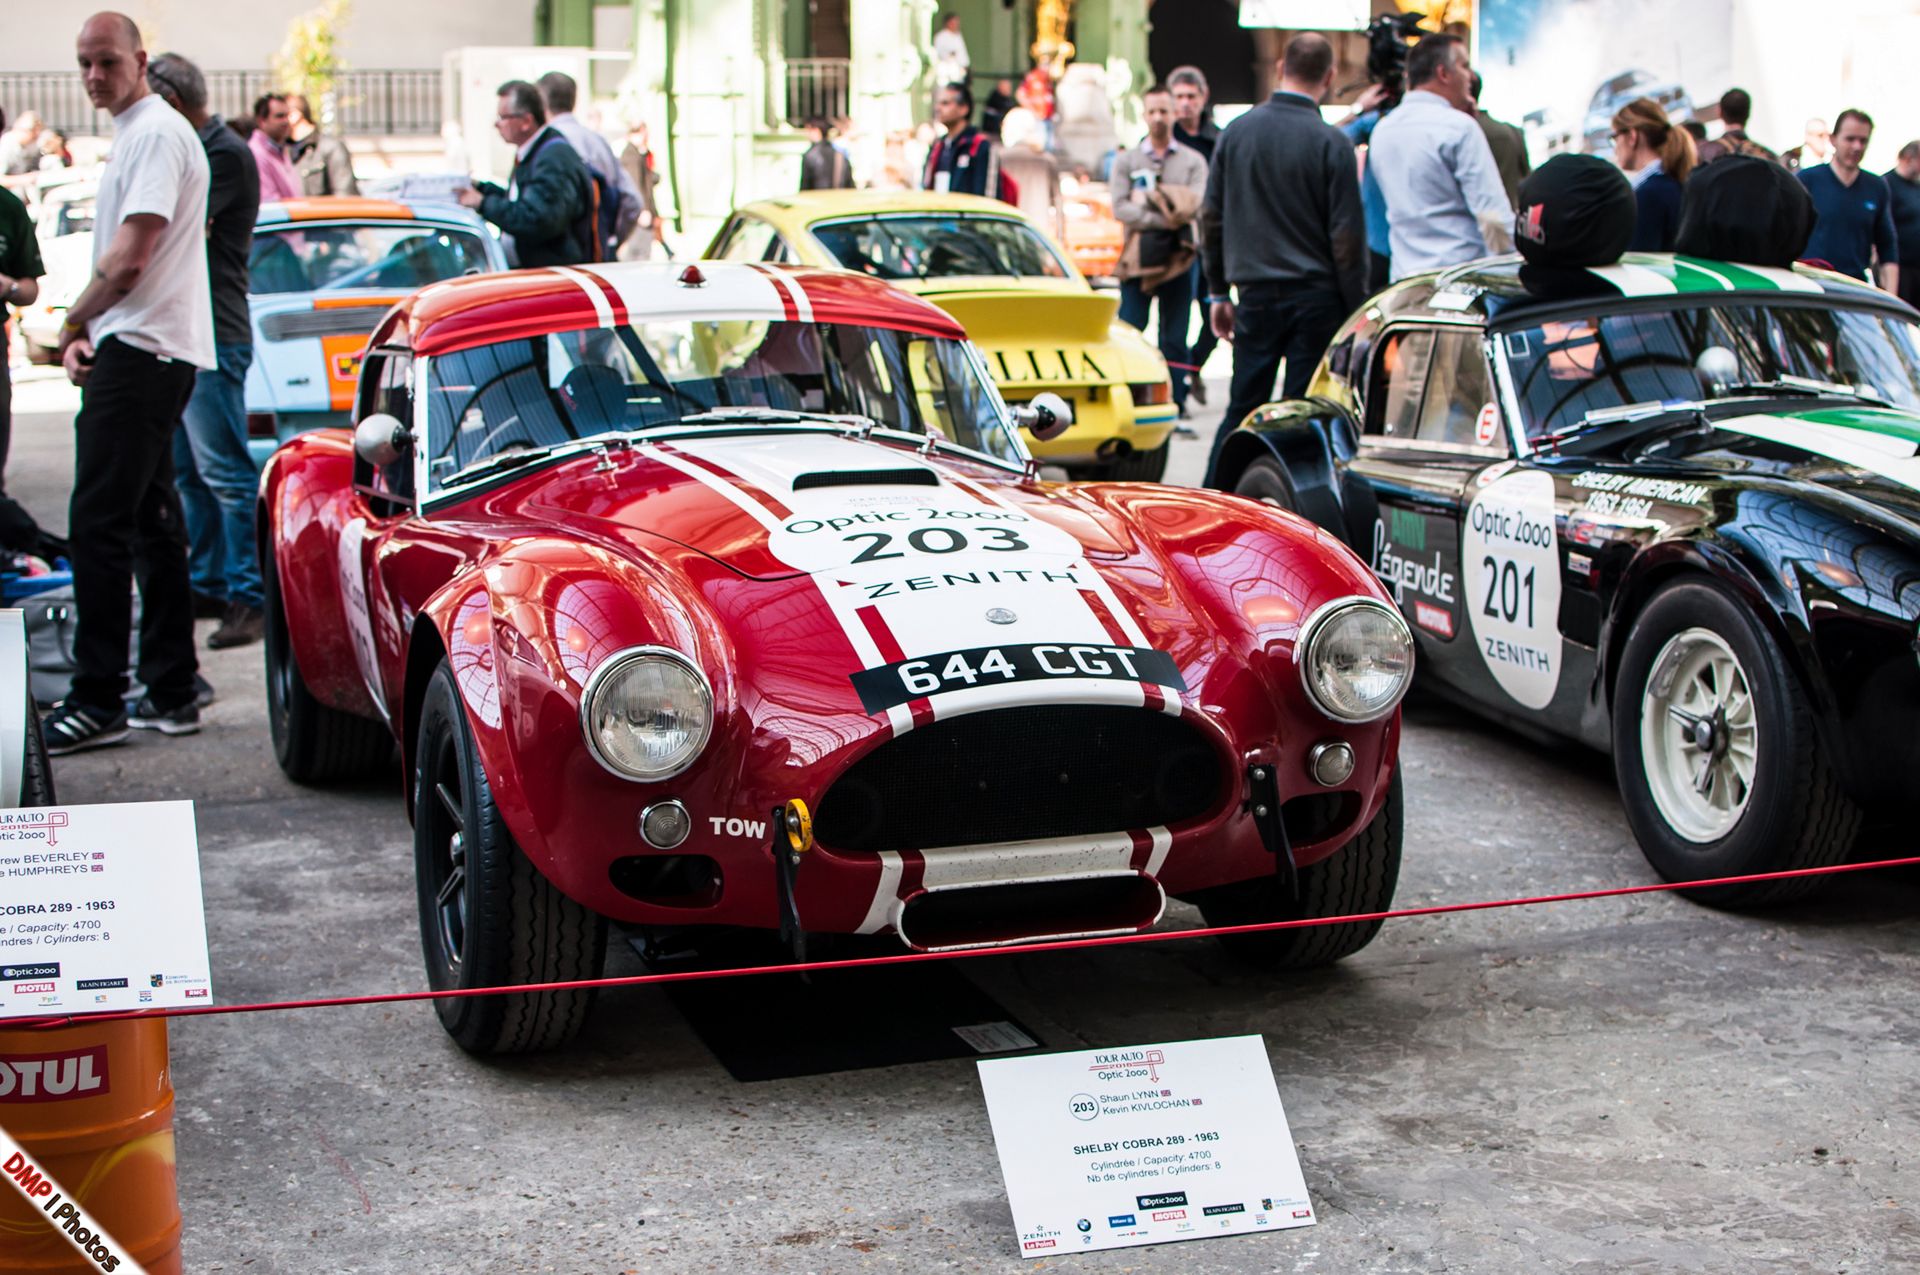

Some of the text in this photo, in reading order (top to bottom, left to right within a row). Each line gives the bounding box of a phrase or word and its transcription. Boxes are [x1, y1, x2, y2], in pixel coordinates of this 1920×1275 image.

[984, 349, 1107, 381] LLIA
[1480, 409, 1494, 440] E
[1572, 471, 1709, 505] SHELBY AMERICAN
[1584, 491, 1654, 519] 1963 1964
[785, 510, 911, 534] Optic
[1472, 502, 1511, 545] Optic
[842, 526, 1030, 565] 203
[863, 569, 1080, 599] ZENITH
[1483, 555, 1536, 629] 201
[1485, 636, 1551, 673] ZENITH
[897, 644, 1140, 695] 644 CGT
[16, 812, 45, 823] AUTO
[708, 816, 767, 839] TOW
[23, 851, 90, 865] BEVERLEY
[8, 864, 89, 878] HUMPHREYS
[50, 902, 73, 914] 289
[85, 900, 116, 911] 1963
[17, 921, 70, 935] Capacity:
[72, 919, 102, 930] 4700
[43, 933, 100, 946] Cylinders:
[103, 931, 111, 941] 8
[15, 982, 54, 993] MOTUL
[1094, 1051, 1144, 1065] TOUR AUTO
[1098, 1069, 1123, 1082] Optic
[1099, 1090, 1160, 1104] Shaun LYNN
[1072, 1101, 1095, 1113] 203
[1102, 1098, 1191, 1116] Kevin KIVLOCHAN
[1073, 1141, 1119, 1156] SHELBY
[1122, 1137, 1165, 1151] COBRA
[1165, 1134, 1186, 1146] 289
[1194, 1131, 1221, 1144] 1963
[1143, 1153, 1187, 1167] Capacity:
[1187, 1150, 1213, 1161] 4700
[1086, 1174, 1102, 1184] Nb
[1103, 1172, 1117, 1182] de
[1118, 1167, 1160, 1181] cylindres
[1167, 1162, 1213, 1176] Cylinders:
[1214, 1160, 1222, 1170] 8
[1153, 1210, 1186, 1221] MOTUL
[1023, 1230, 1061, 1240] ZENITH
[1026, 1239, 1055, 1250] Le Point
